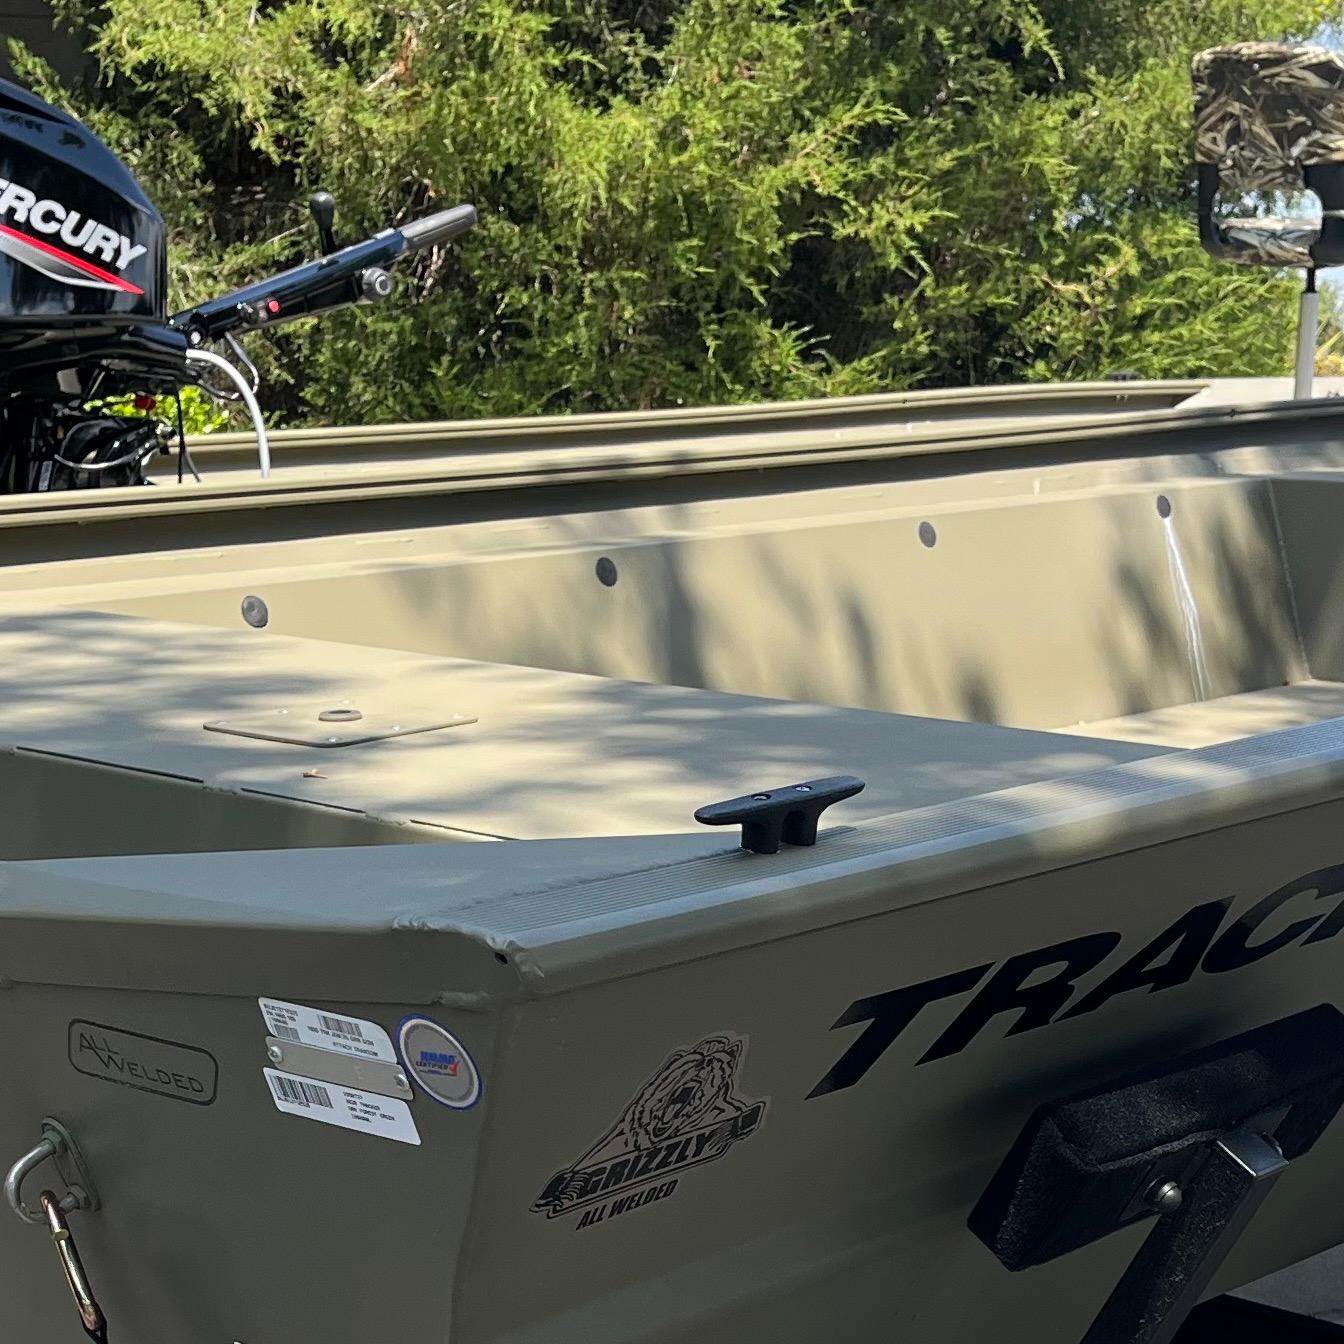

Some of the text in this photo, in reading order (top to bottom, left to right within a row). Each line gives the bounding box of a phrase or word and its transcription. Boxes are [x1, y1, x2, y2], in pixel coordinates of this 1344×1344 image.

[79, 1032, 121, 1056] ALL
[94, 1050, 205, 1094] WELDED
[582, 1132, 713, 1197] GRIZZLY
[575, 1179, 680, 1231] ALL WELDED
